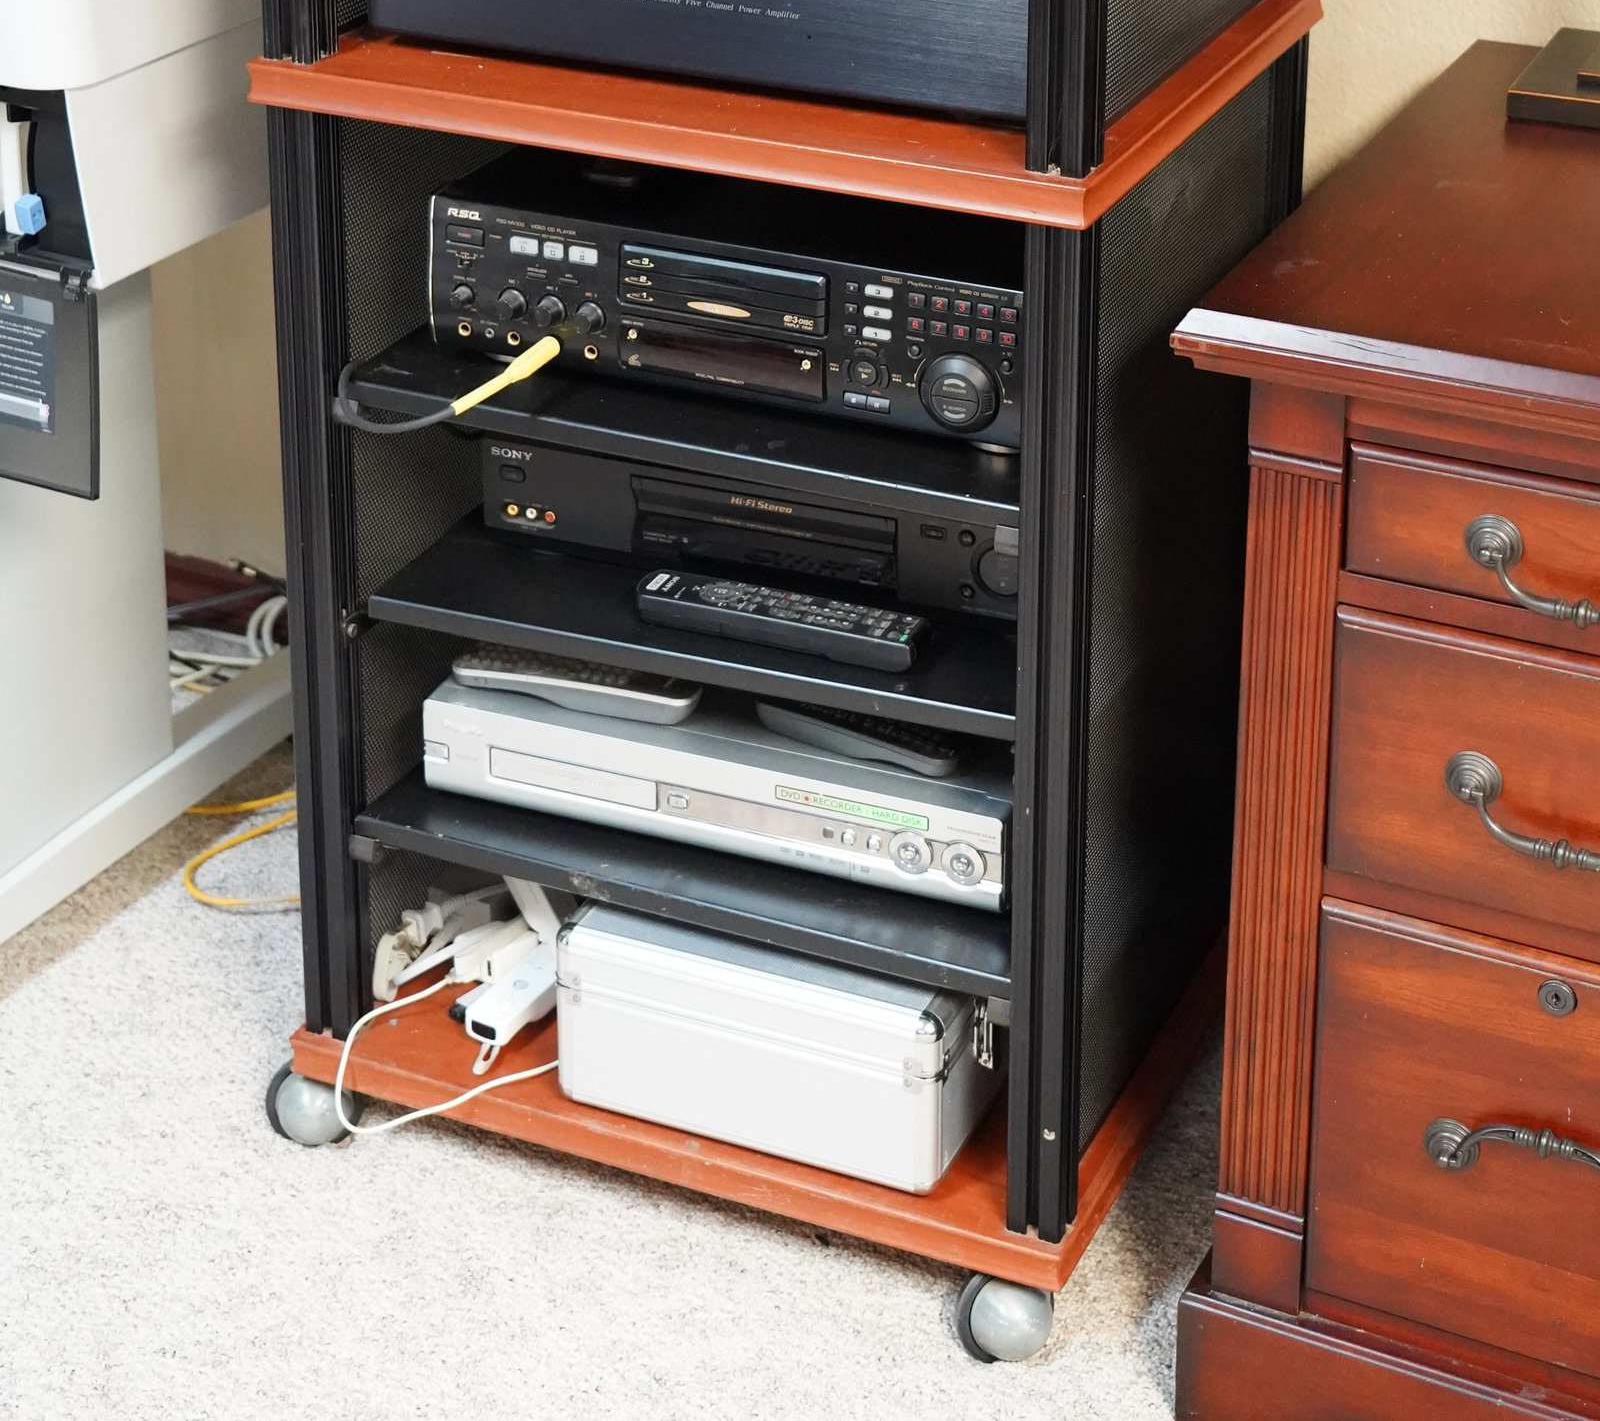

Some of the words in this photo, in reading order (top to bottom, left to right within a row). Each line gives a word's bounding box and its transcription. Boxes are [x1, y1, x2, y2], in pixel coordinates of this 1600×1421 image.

[706, 0, 734, 12] Channel
[738, 5, 762, 16] Power
[765, 8, 800, 20] Amplifier
[447, 207, 483, 221] RSQ
[641, 257, 650, 265] 3
[934, 284, 955, 292] Control
[982, 307, 989, 315] 4
[1005, 311, 1012, 319] 5
[935, 324, 942, 332] 7
[958, 328, 964, 336] 8
[1003, 336, 1012, 344] 10
[491, 446, 533, 461] SONY
[757, 500, 793, 514] Stereo
[780, 788, 800, 800] DVD
[813, 796, 862, 814] RECORDER
[872, 808, 899, 822] HARD
[901, 814, 922, 827] DISK
